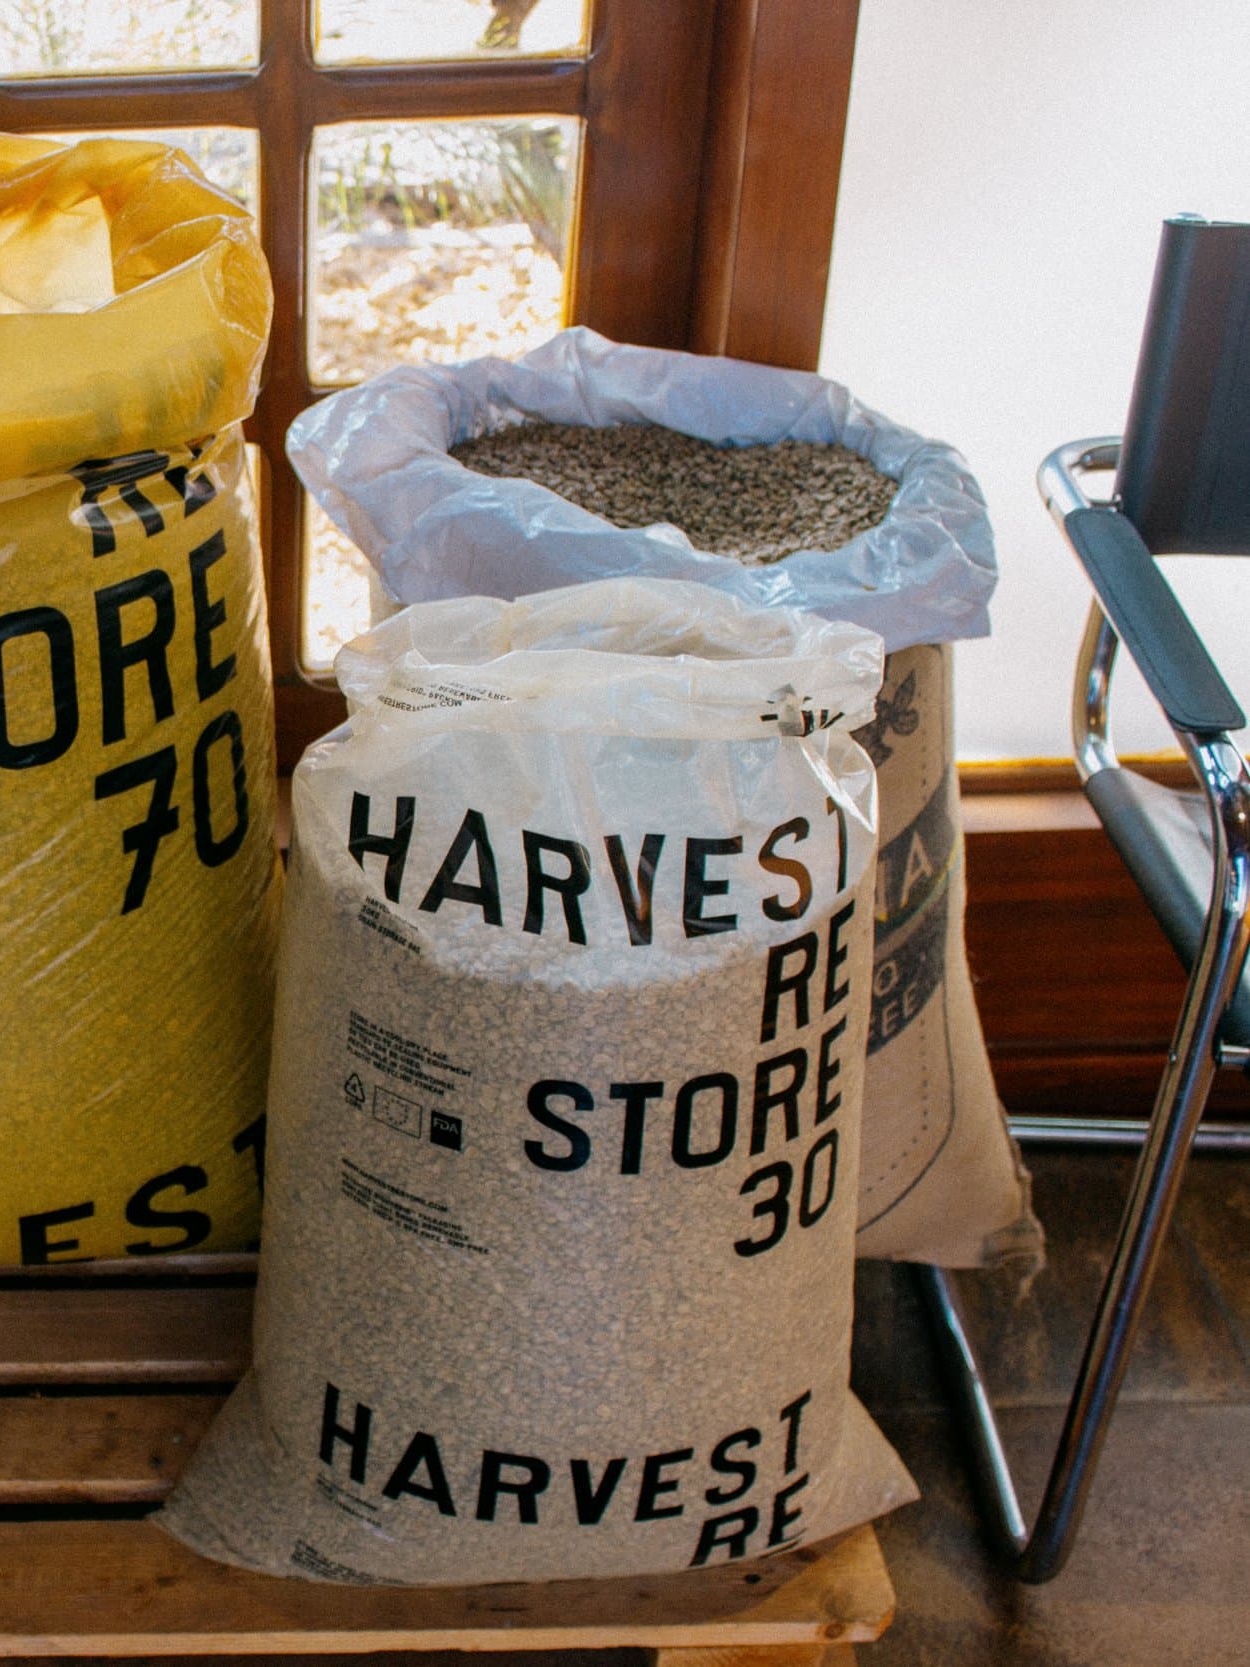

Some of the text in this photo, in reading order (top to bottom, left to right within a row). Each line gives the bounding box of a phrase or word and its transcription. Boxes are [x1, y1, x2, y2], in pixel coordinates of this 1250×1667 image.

[95, 709, 249, 915] 70
[349, 791, 848, 946] HARVEST
[760, 900, 855, 1044] RE
[433, 1117, 459, 1135] FDA
[525, 1014, 847, 1175] STORE
[734, 1128, 839, 1258] 30
[319, 1382, 812, 1526] HARVEST
[690, 1474, 810, 1567] RE
